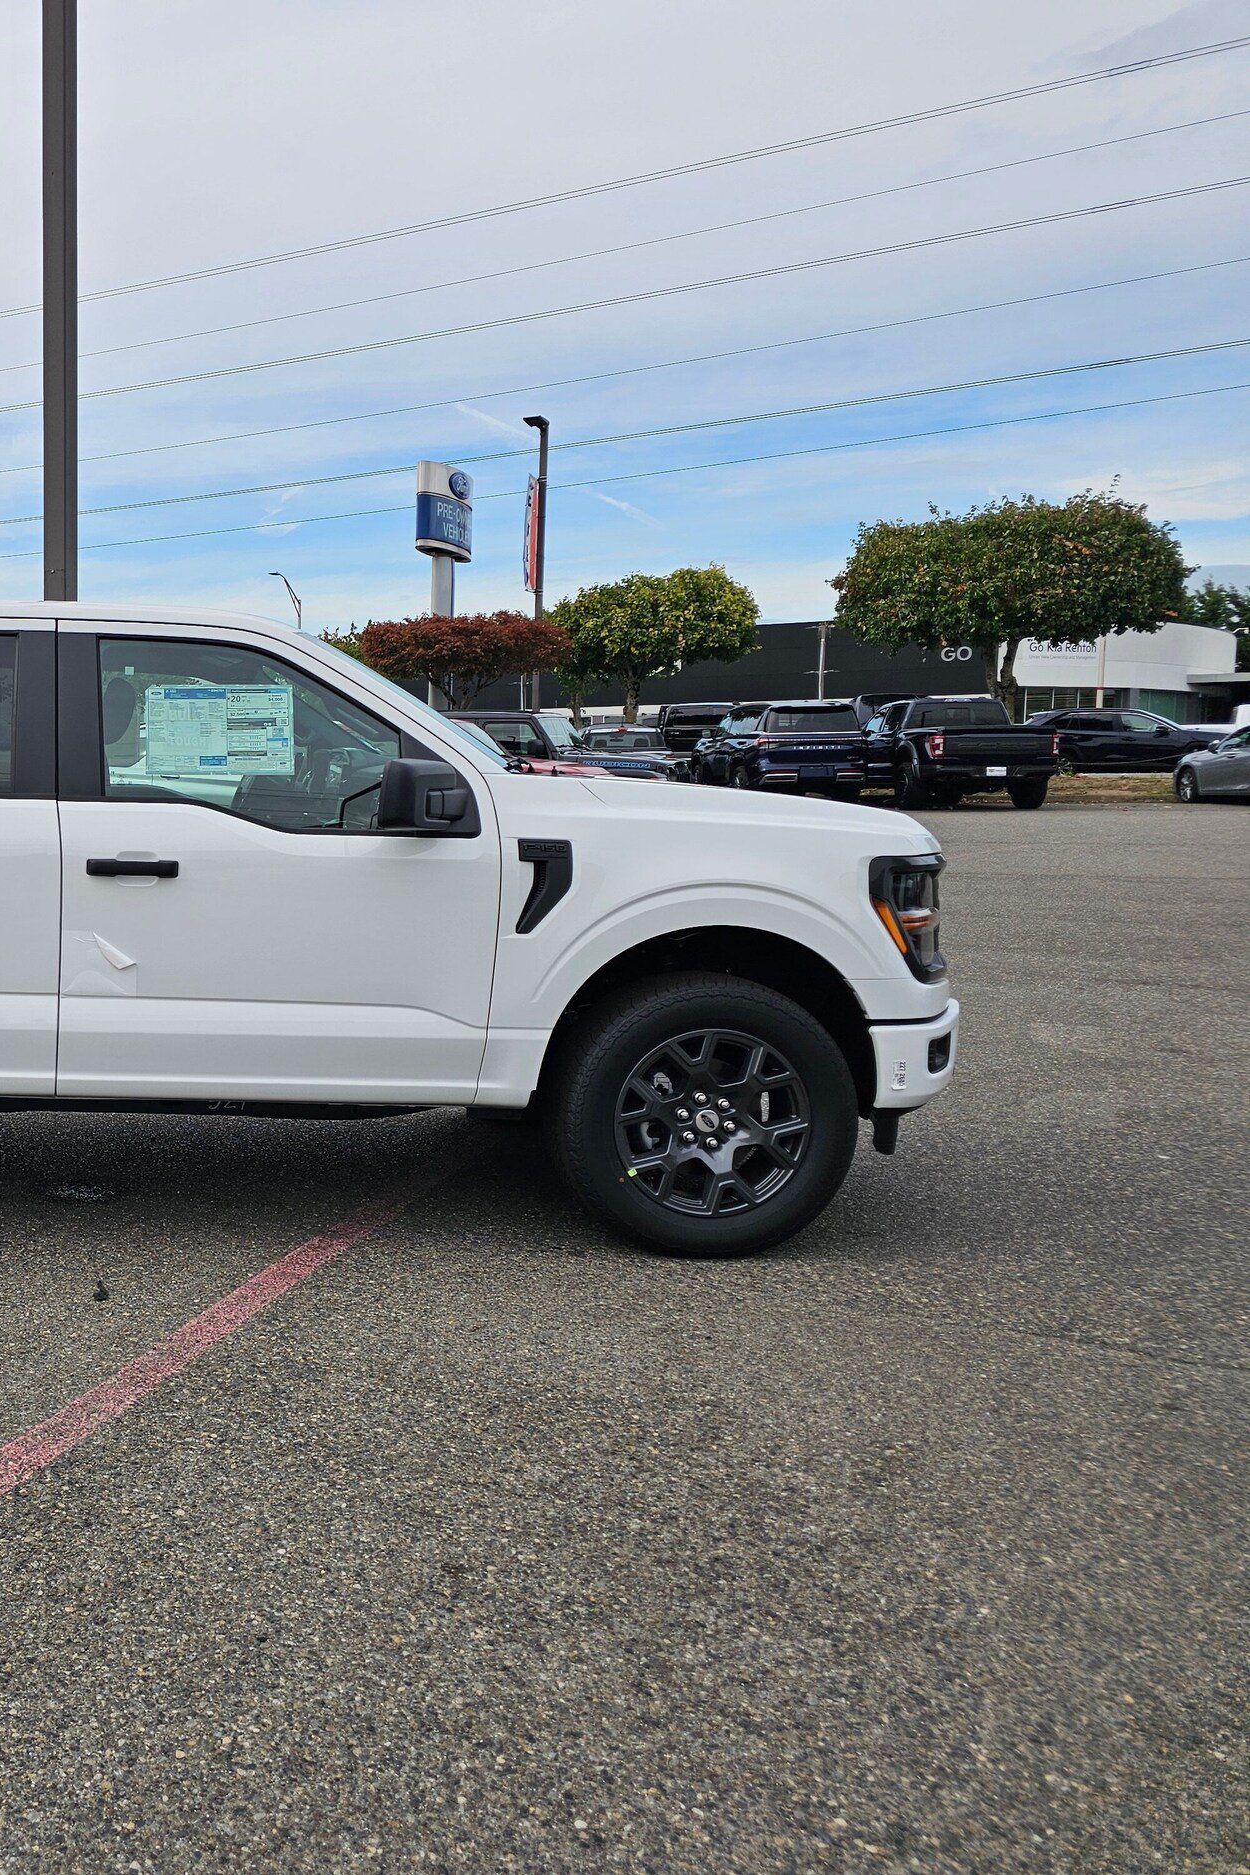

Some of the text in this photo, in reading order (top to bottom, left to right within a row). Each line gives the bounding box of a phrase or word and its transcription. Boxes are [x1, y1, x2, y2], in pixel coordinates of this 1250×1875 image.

[1029, 641, 1044, 652] Go
[1065, 642, 1097, 653] Renton
[941, 646, 972, 661] GO
[230, 695, 241, 703] 20
[582, 760, 651, 769] RUBICON
[523, 842, 568, 853] F-150
